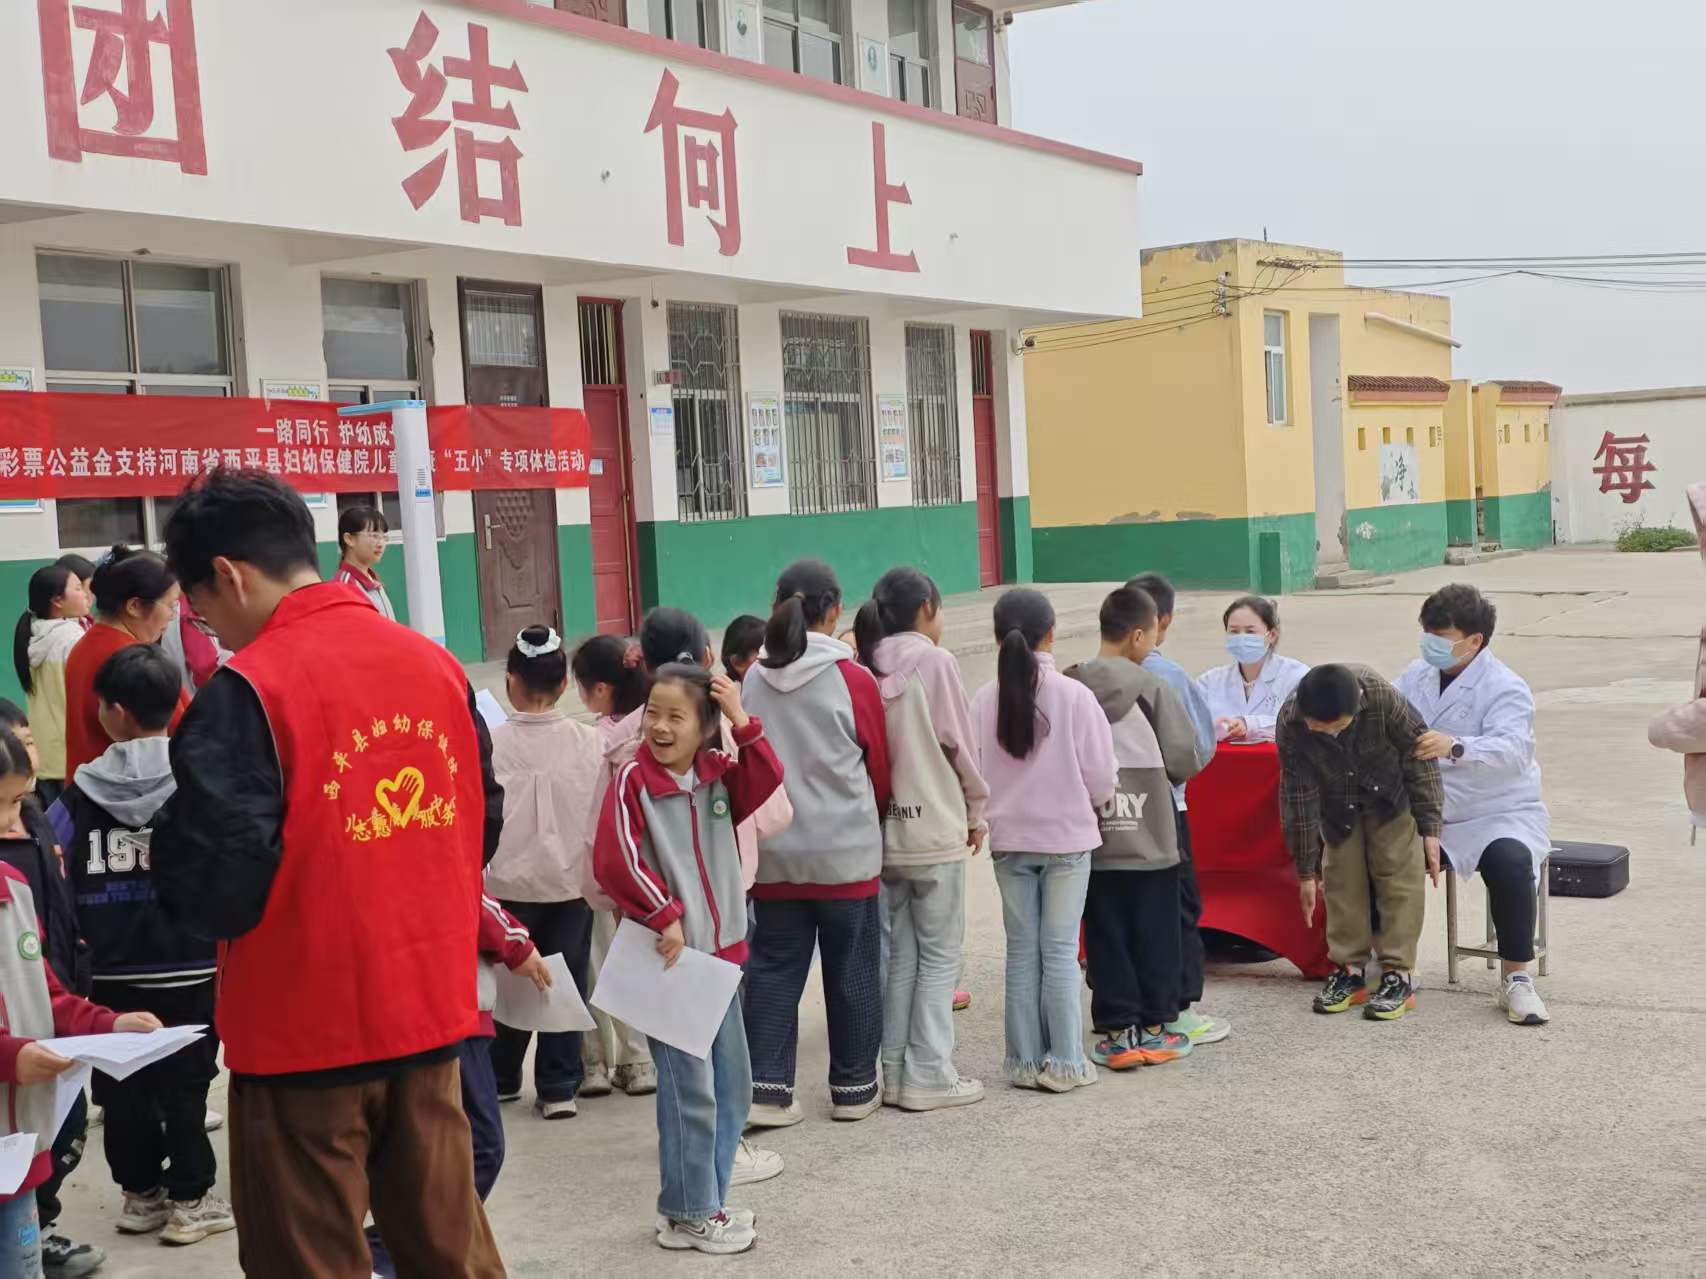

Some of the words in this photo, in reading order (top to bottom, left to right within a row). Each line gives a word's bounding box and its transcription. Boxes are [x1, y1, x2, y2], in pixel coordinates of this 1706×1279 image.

[40, 0, 921, 273] 团结向上
[257, 418, 329, 446] 一路同行
[338, 420, 394, 446] 护幼成
[1592, 430, 1656, 504] 每
